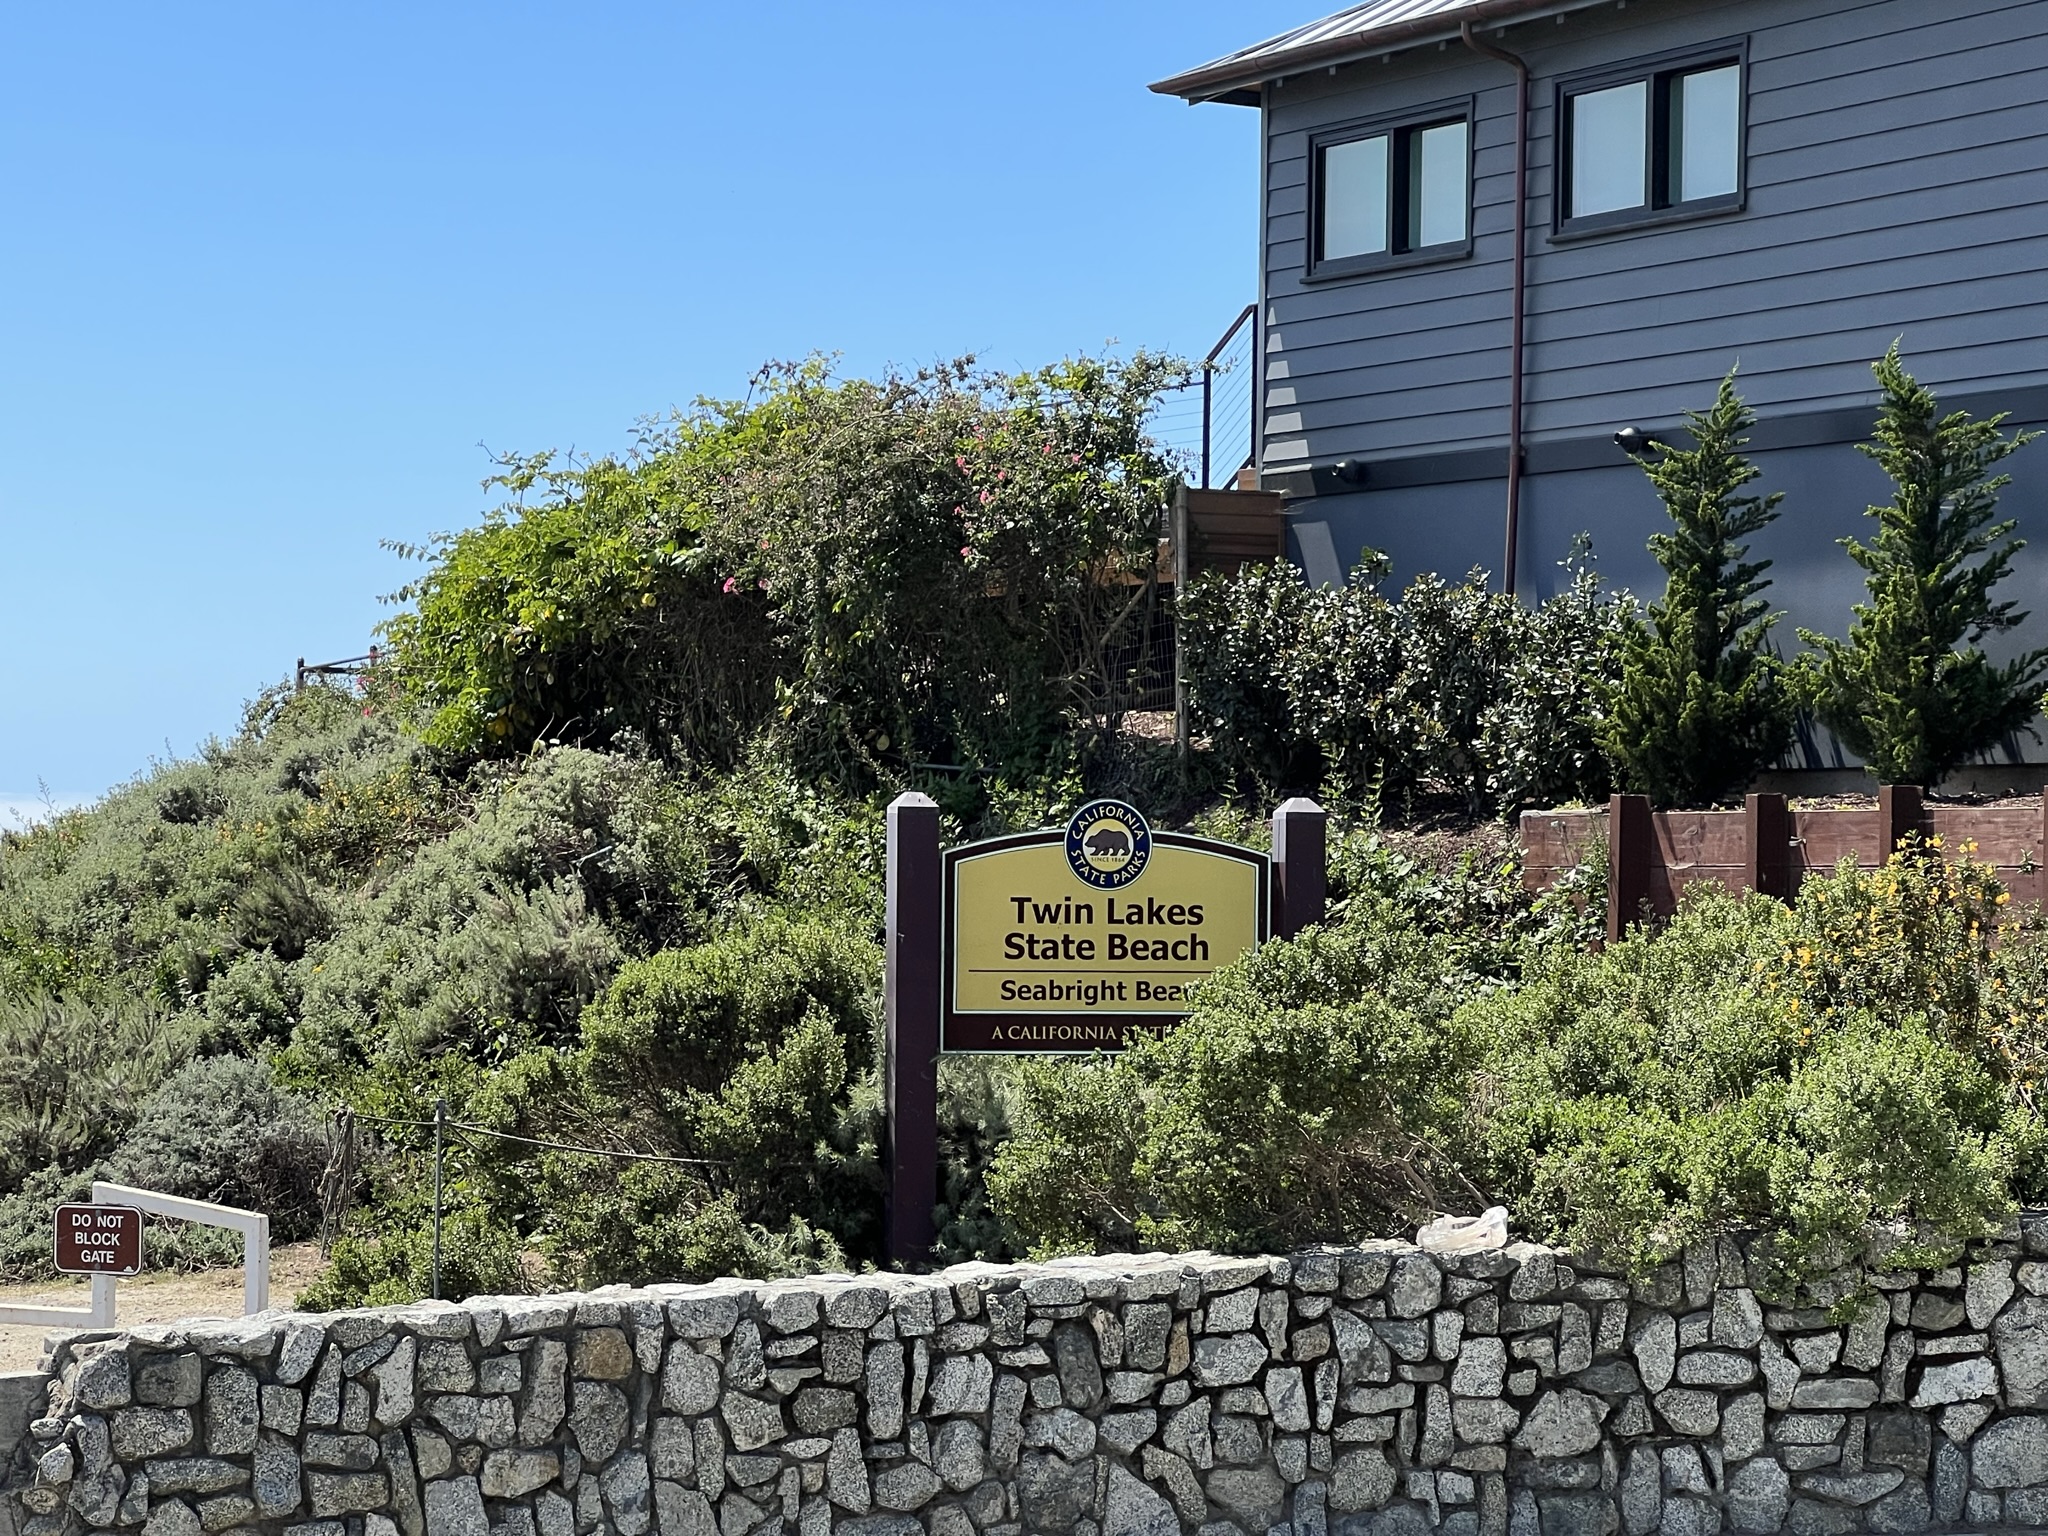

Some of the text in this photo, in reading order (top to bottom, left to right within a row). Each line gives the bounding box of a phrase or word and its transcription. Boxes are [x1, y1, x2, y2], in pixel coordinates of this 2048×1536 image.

[1072, 805, 1145, 841] CALIFORNIA
[1070, 849, 1146, 885] STATE PARKS
[1010, 896, 1204, 926] Twin Lakes
[1003, 932, 1210, 961] State Beach
[1000, 979, 1127, 1006] Seabright
[991, 1025, 1004, 1040] A
[1007, 1025, 1117, 1040] CALIFORNIA
[72, 1213, 124, 1228] DO NOT
[74, 1231, 121, 1247] BLOCK
[80, 1249, 115, 1264] GATE
